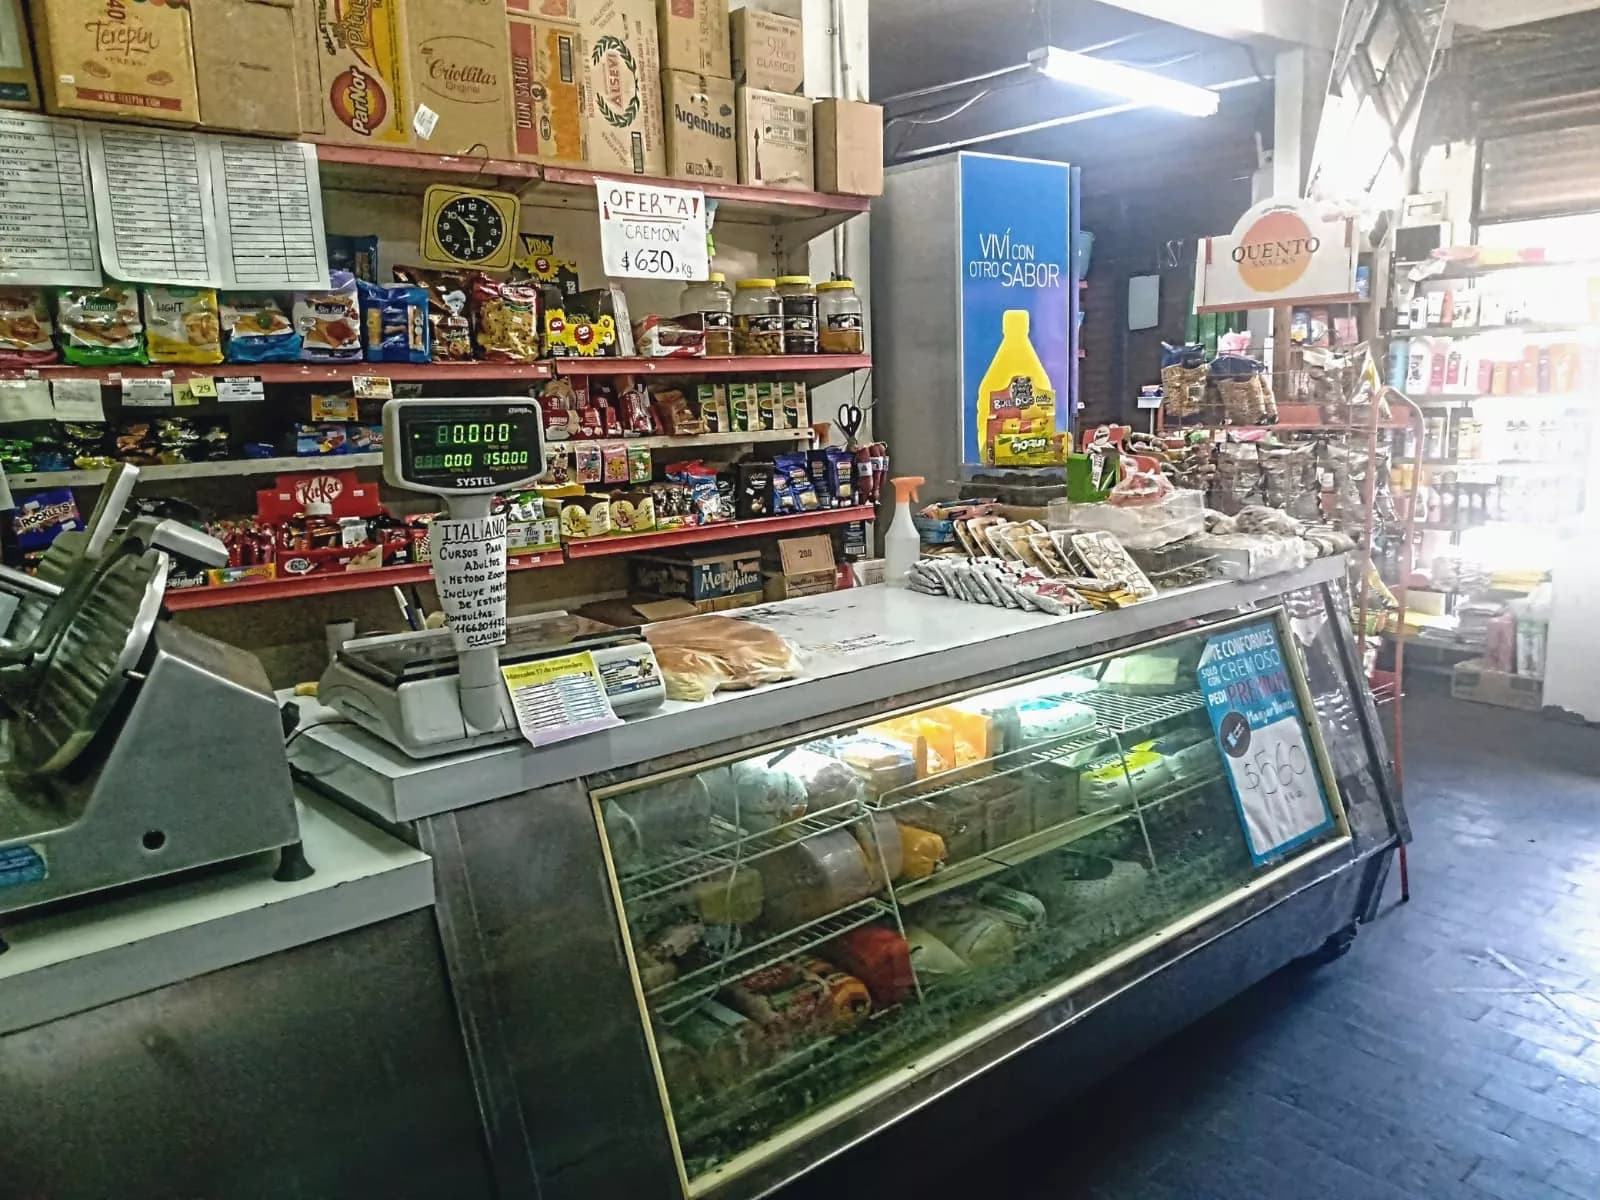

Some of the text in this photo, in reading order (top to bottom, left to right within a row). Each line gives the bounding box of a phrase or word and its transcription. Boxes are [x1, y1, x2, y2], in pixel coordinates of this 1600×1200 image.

[85, 20, 160, 55] Terepin
[429, 58, 497, 86] Criollitas
[351, 66, 372, 136] ParNor
[512, 57, 532, 129] DON SATUR
[447, 211, 457, 219] 10
[458, 204, 465, 212] 11
[468, 203, 477, 211] 12
[488, 216, 495, 224] 2
[477, 246, 483, 254] 5
[979, 227, 1034, 261] VIVÍ CON
[1231, 236, 1320, 264] QUENTO
[969, 261, 1060, 288] OTRO SABOR
[157, 302, 184, 312] LIGHT
[197, 384, 211, 394] 29
[456, 477, 496, 488] SYSTEL
[21, 503, 72, 529] ROCKLETS
[442, 519, 506, 541] ITALIANO
[440, 546, 479, 560] CURSOS
[1222, 628, 1274, 657] CONFORMES
[1220, 649, 1280, 680] CREMOSO
